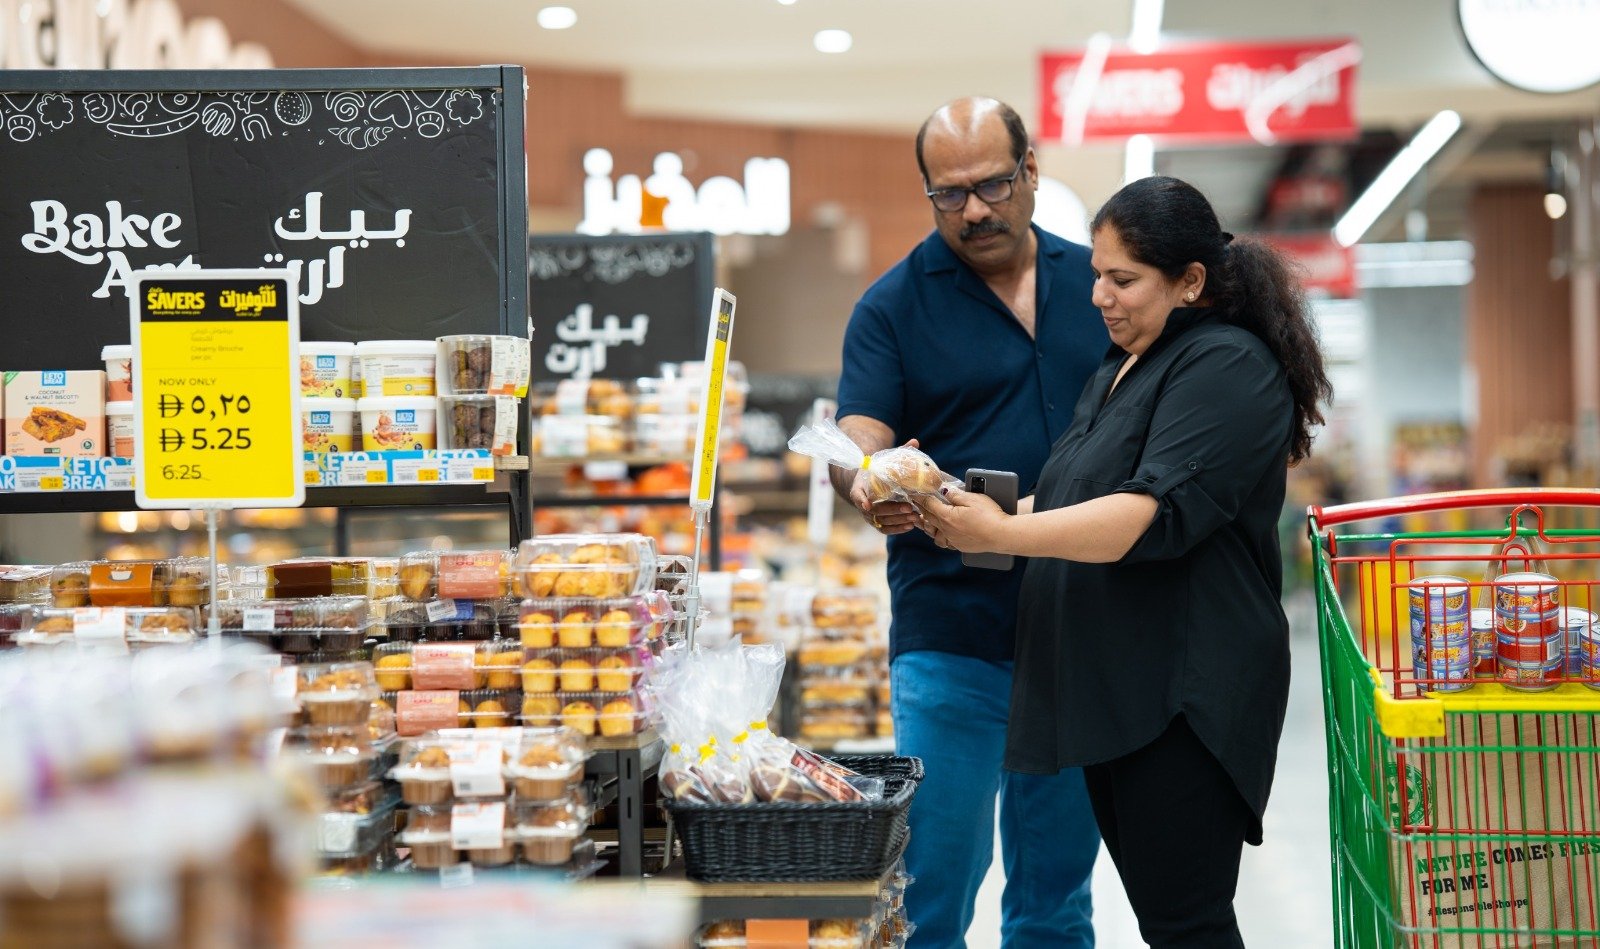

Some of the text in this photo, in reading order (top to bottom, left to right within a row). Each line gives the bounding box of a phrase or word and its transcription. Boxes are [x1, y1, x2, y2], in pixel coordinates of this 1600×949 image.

[274, 191, 413, 248] بيك
[21, 200, 182, 264] Bake
[147, 292, 206, 311] SAVERS
[159, 378, 216, 386] NOW ONLY
[192, 428, 251, 450] 5.25
[60, 456, 117, 476] KETO
[162, 464, 202, 480] 6.25
[62, 475, 105, 490] BREA
[1416, 852, 1488, 874] NATURE
[1492, 843, 1555, 865] COMES
[1421, 874, 1489, 896] FOR ME
